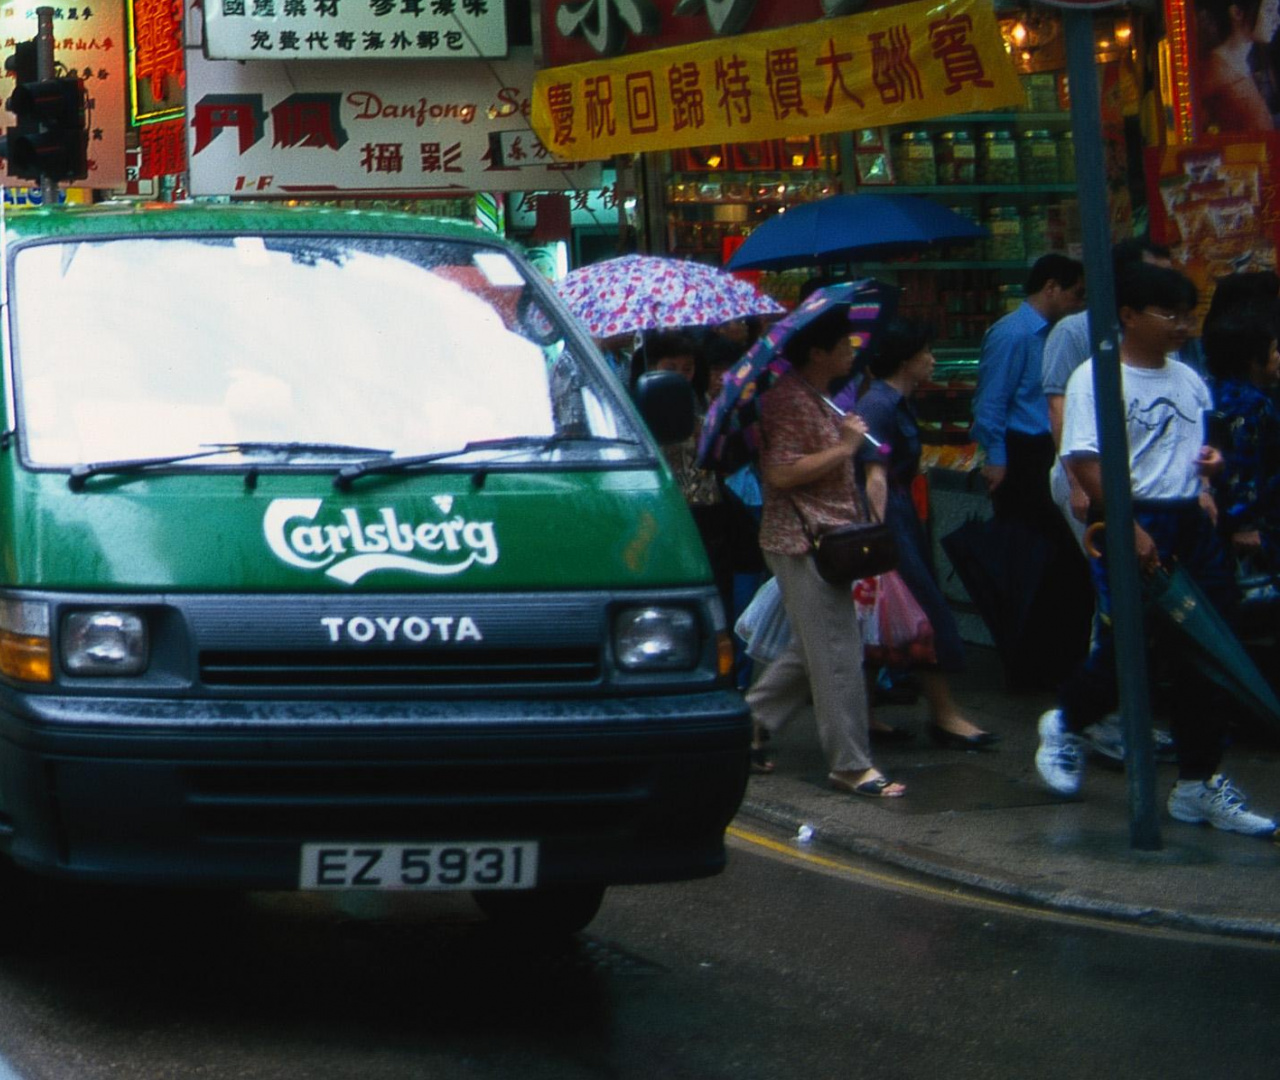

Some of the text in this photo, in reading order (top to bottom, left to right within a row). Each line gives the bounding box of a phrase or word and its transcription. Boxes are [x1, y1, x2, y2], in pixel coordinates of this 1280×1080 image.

[547, 14, 994, 147] 慶祝回歸特價大酬賓
[345, 90, 478, 128] Danfong
[263, 496, 499, 585] Carlsberg
[321, 616, 483, 644] TOYOTA
[316, 845, 528, 886] EZ 5931
